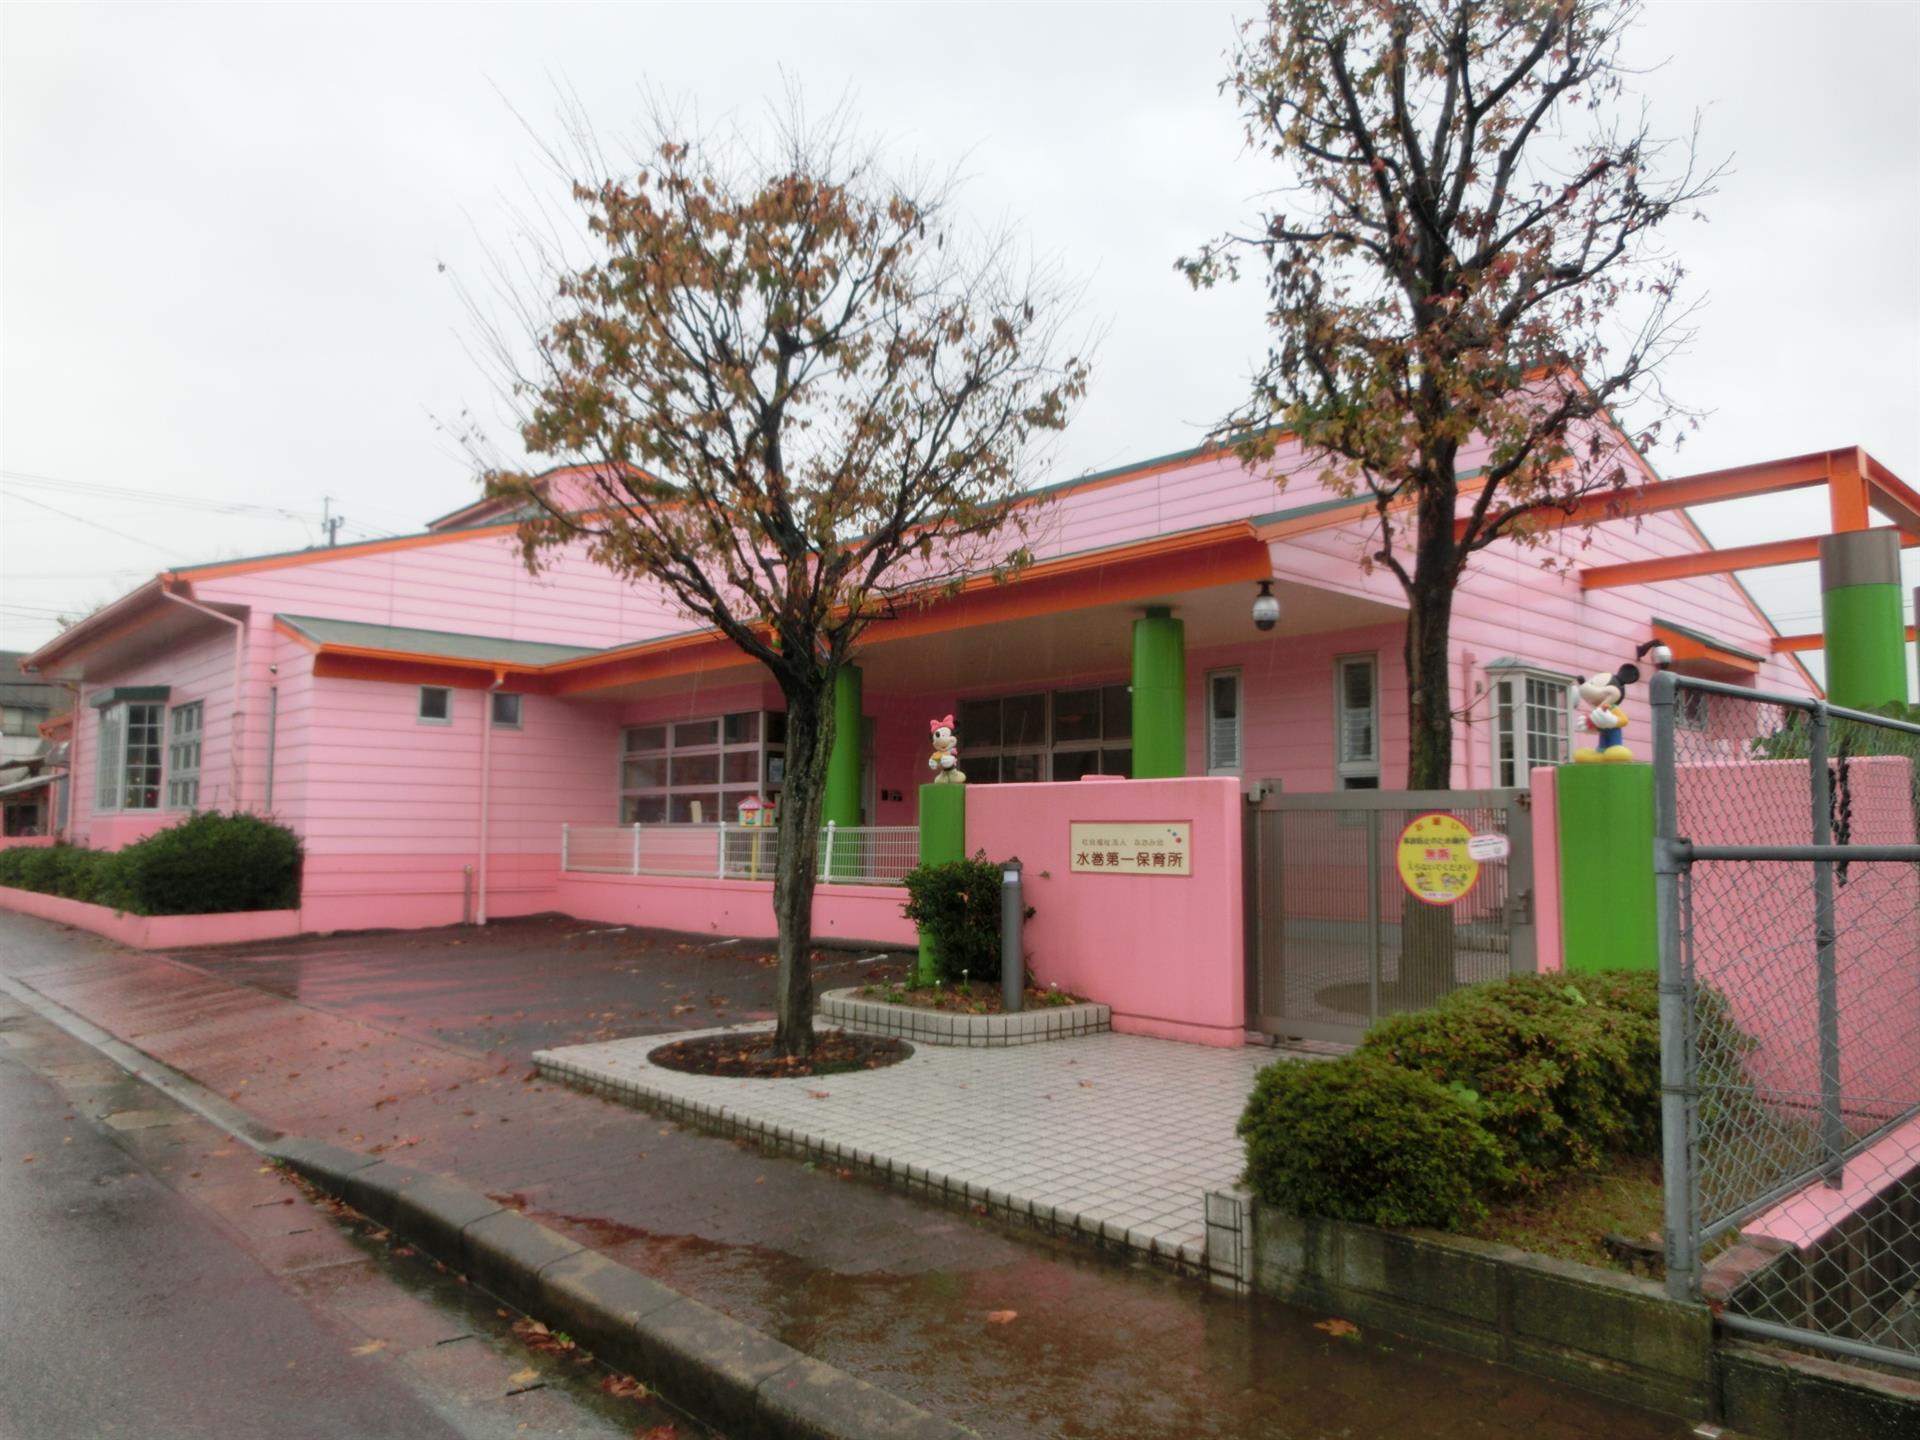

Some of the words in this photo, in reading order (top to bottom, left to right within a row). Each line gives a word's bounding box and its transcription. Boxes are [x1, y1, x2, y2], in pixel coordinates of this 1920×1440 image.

[1076, 851, 1183, 868] 水巻第一保育所
